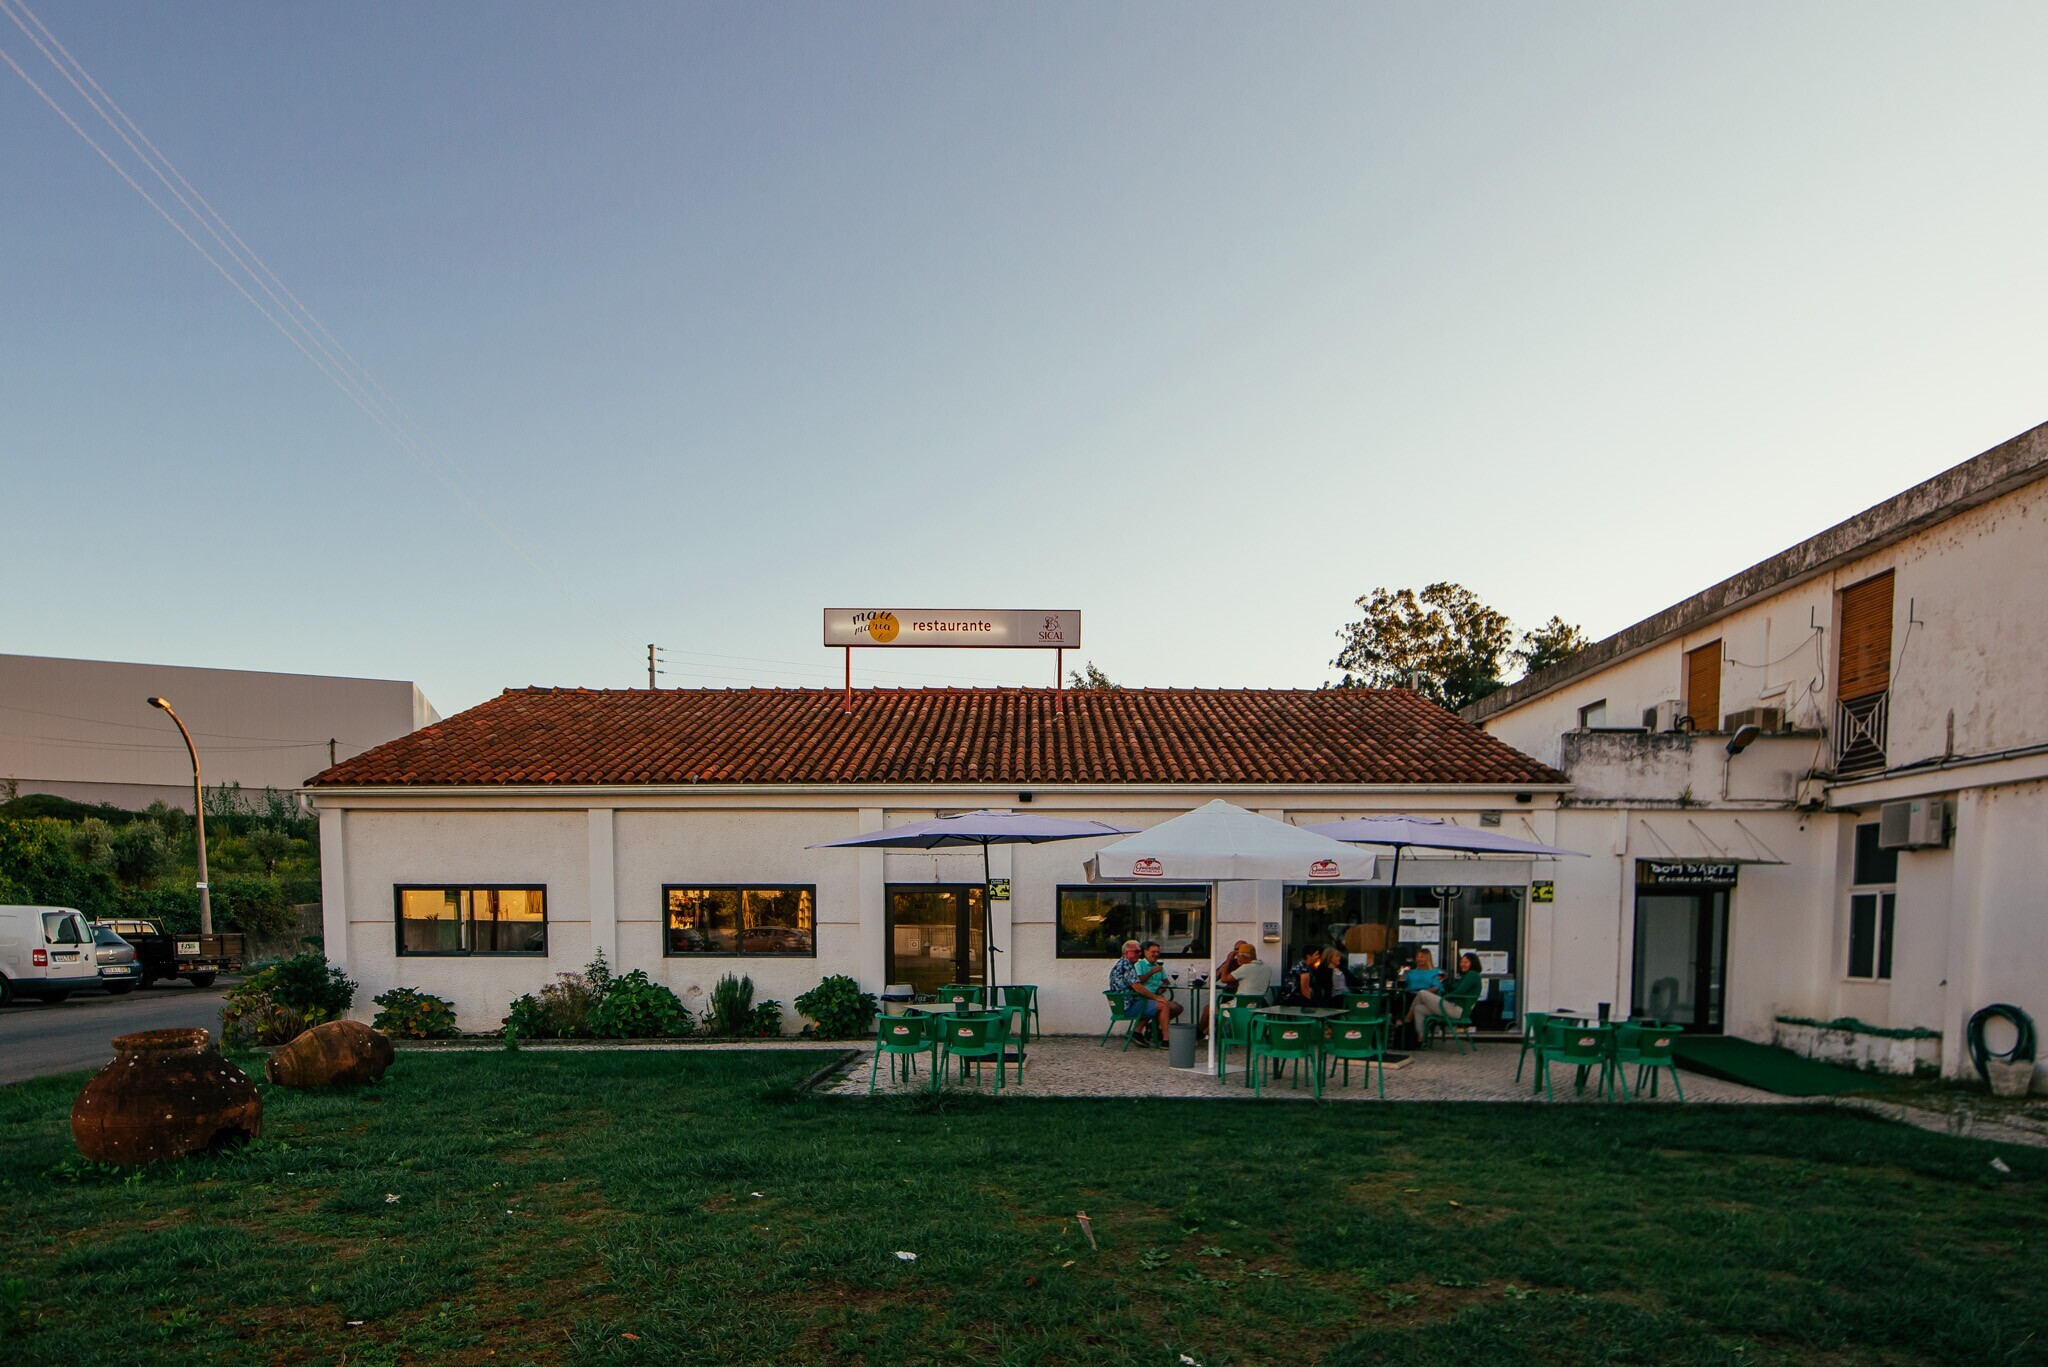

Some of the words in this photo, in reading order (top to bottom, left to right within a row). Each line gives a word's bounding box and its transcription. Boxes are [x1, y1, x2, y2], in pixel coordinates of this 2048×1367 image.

[854, 621, 892, 635] maria
[912, 619, 992, 632] restaurante
[1038, 631, 1064, 640] SICAL
[1650, 863, 1683, 874] DOM
